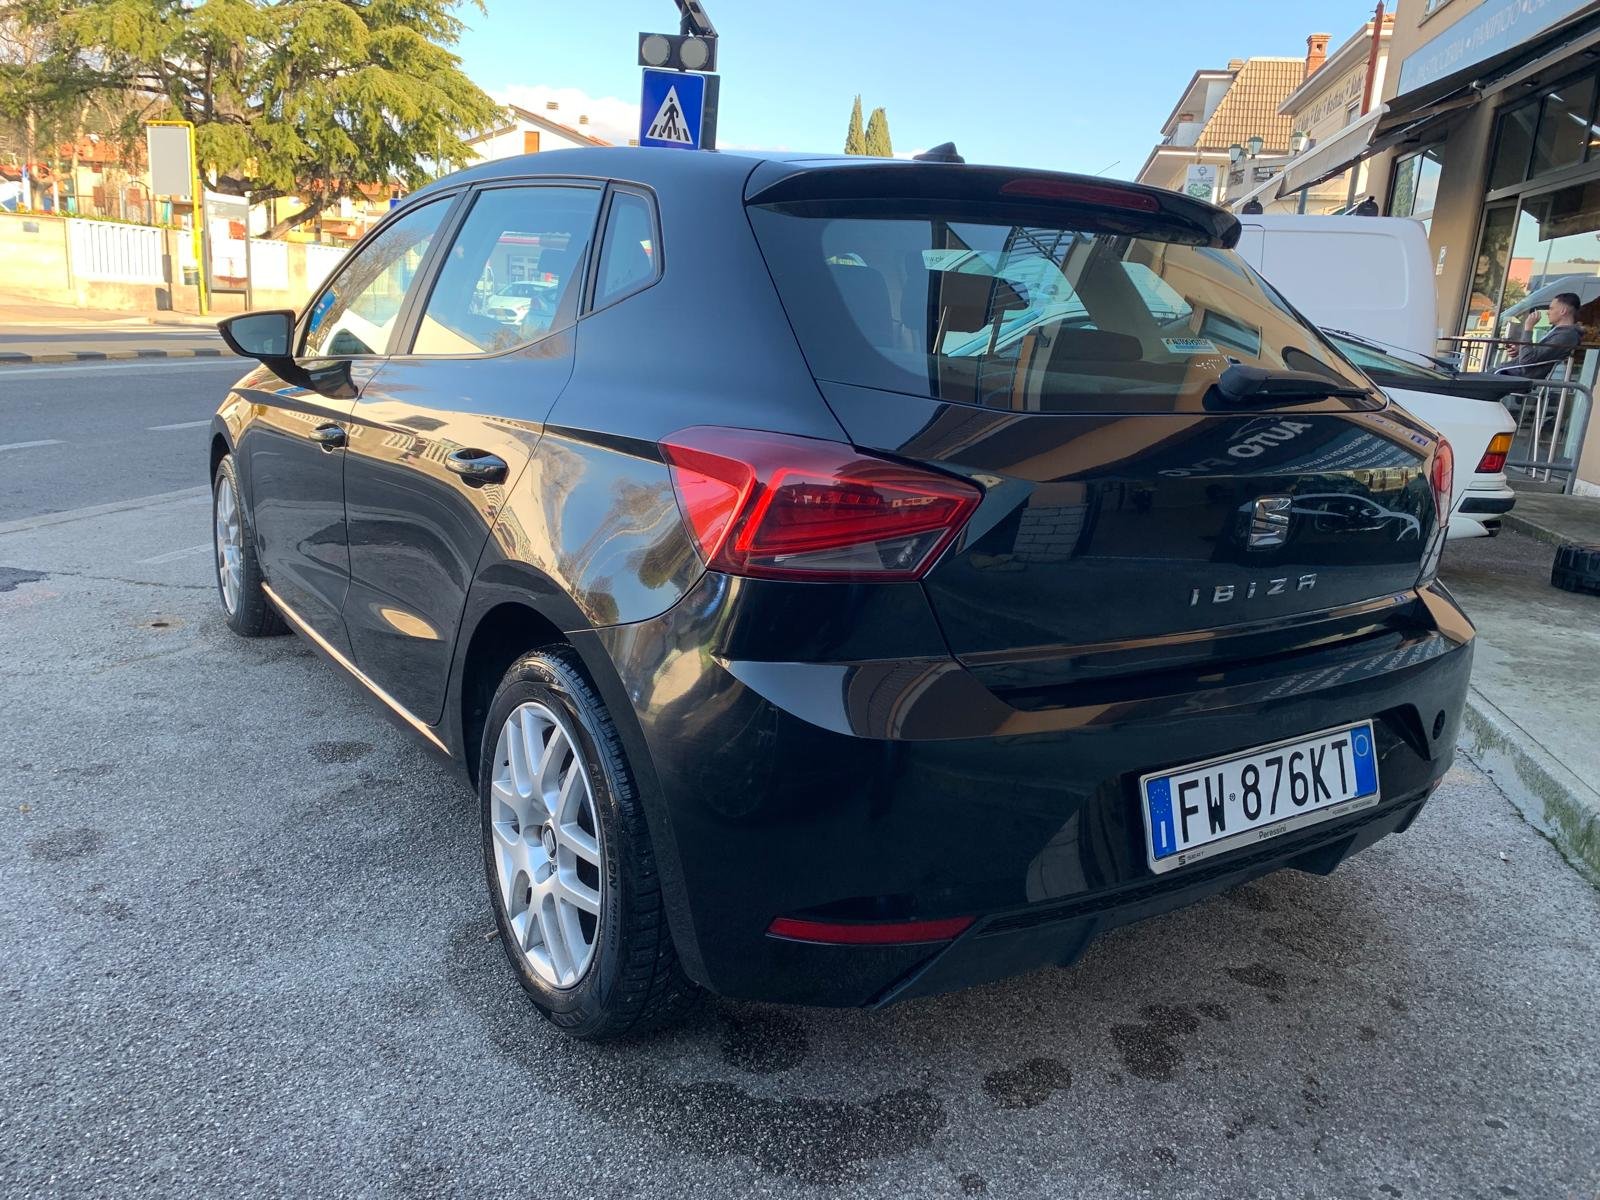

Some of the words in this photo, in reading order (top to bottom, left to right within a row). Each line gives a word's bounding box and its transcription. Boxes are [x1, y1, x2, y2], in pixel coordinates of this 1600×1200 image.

[1190, 573, 1318, 606] IBIZA
[1178, 772, 1226, 843] FW
[1241, 739, 1348, 821] 876KT
